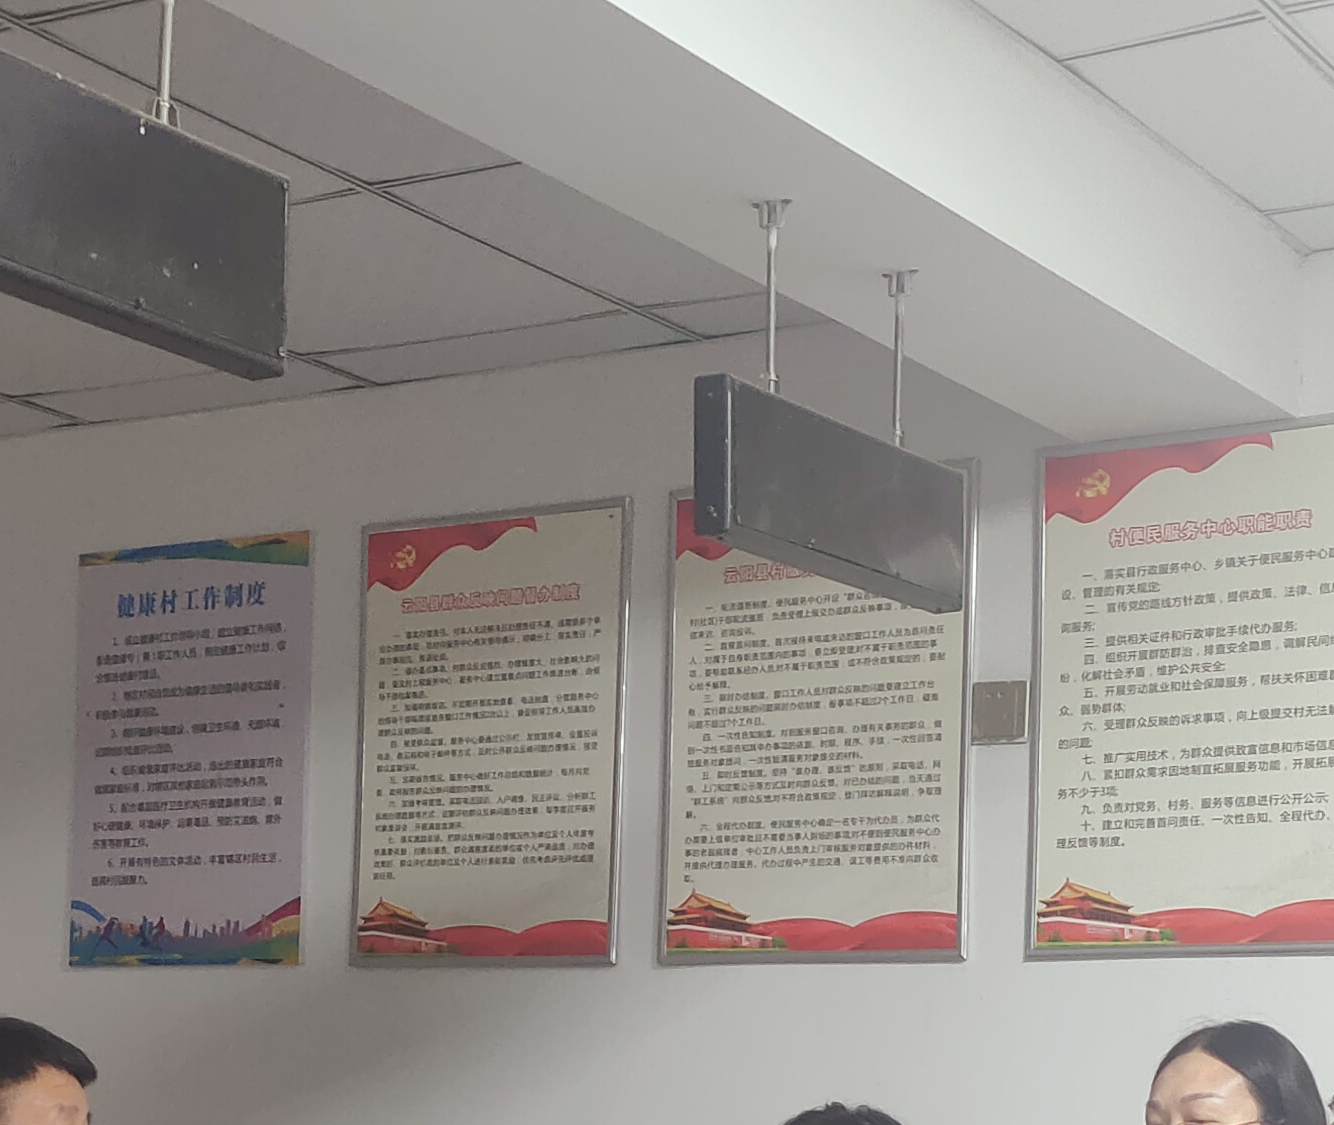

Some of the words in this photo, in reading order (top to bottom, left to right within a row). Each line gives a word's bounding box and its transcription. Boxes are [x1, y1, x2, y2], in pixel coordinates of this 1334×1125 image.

[1108, 508, 1313, 549] 村便民服务中心职能职责
[117, 581, 266, 618] 健康村工作制度
